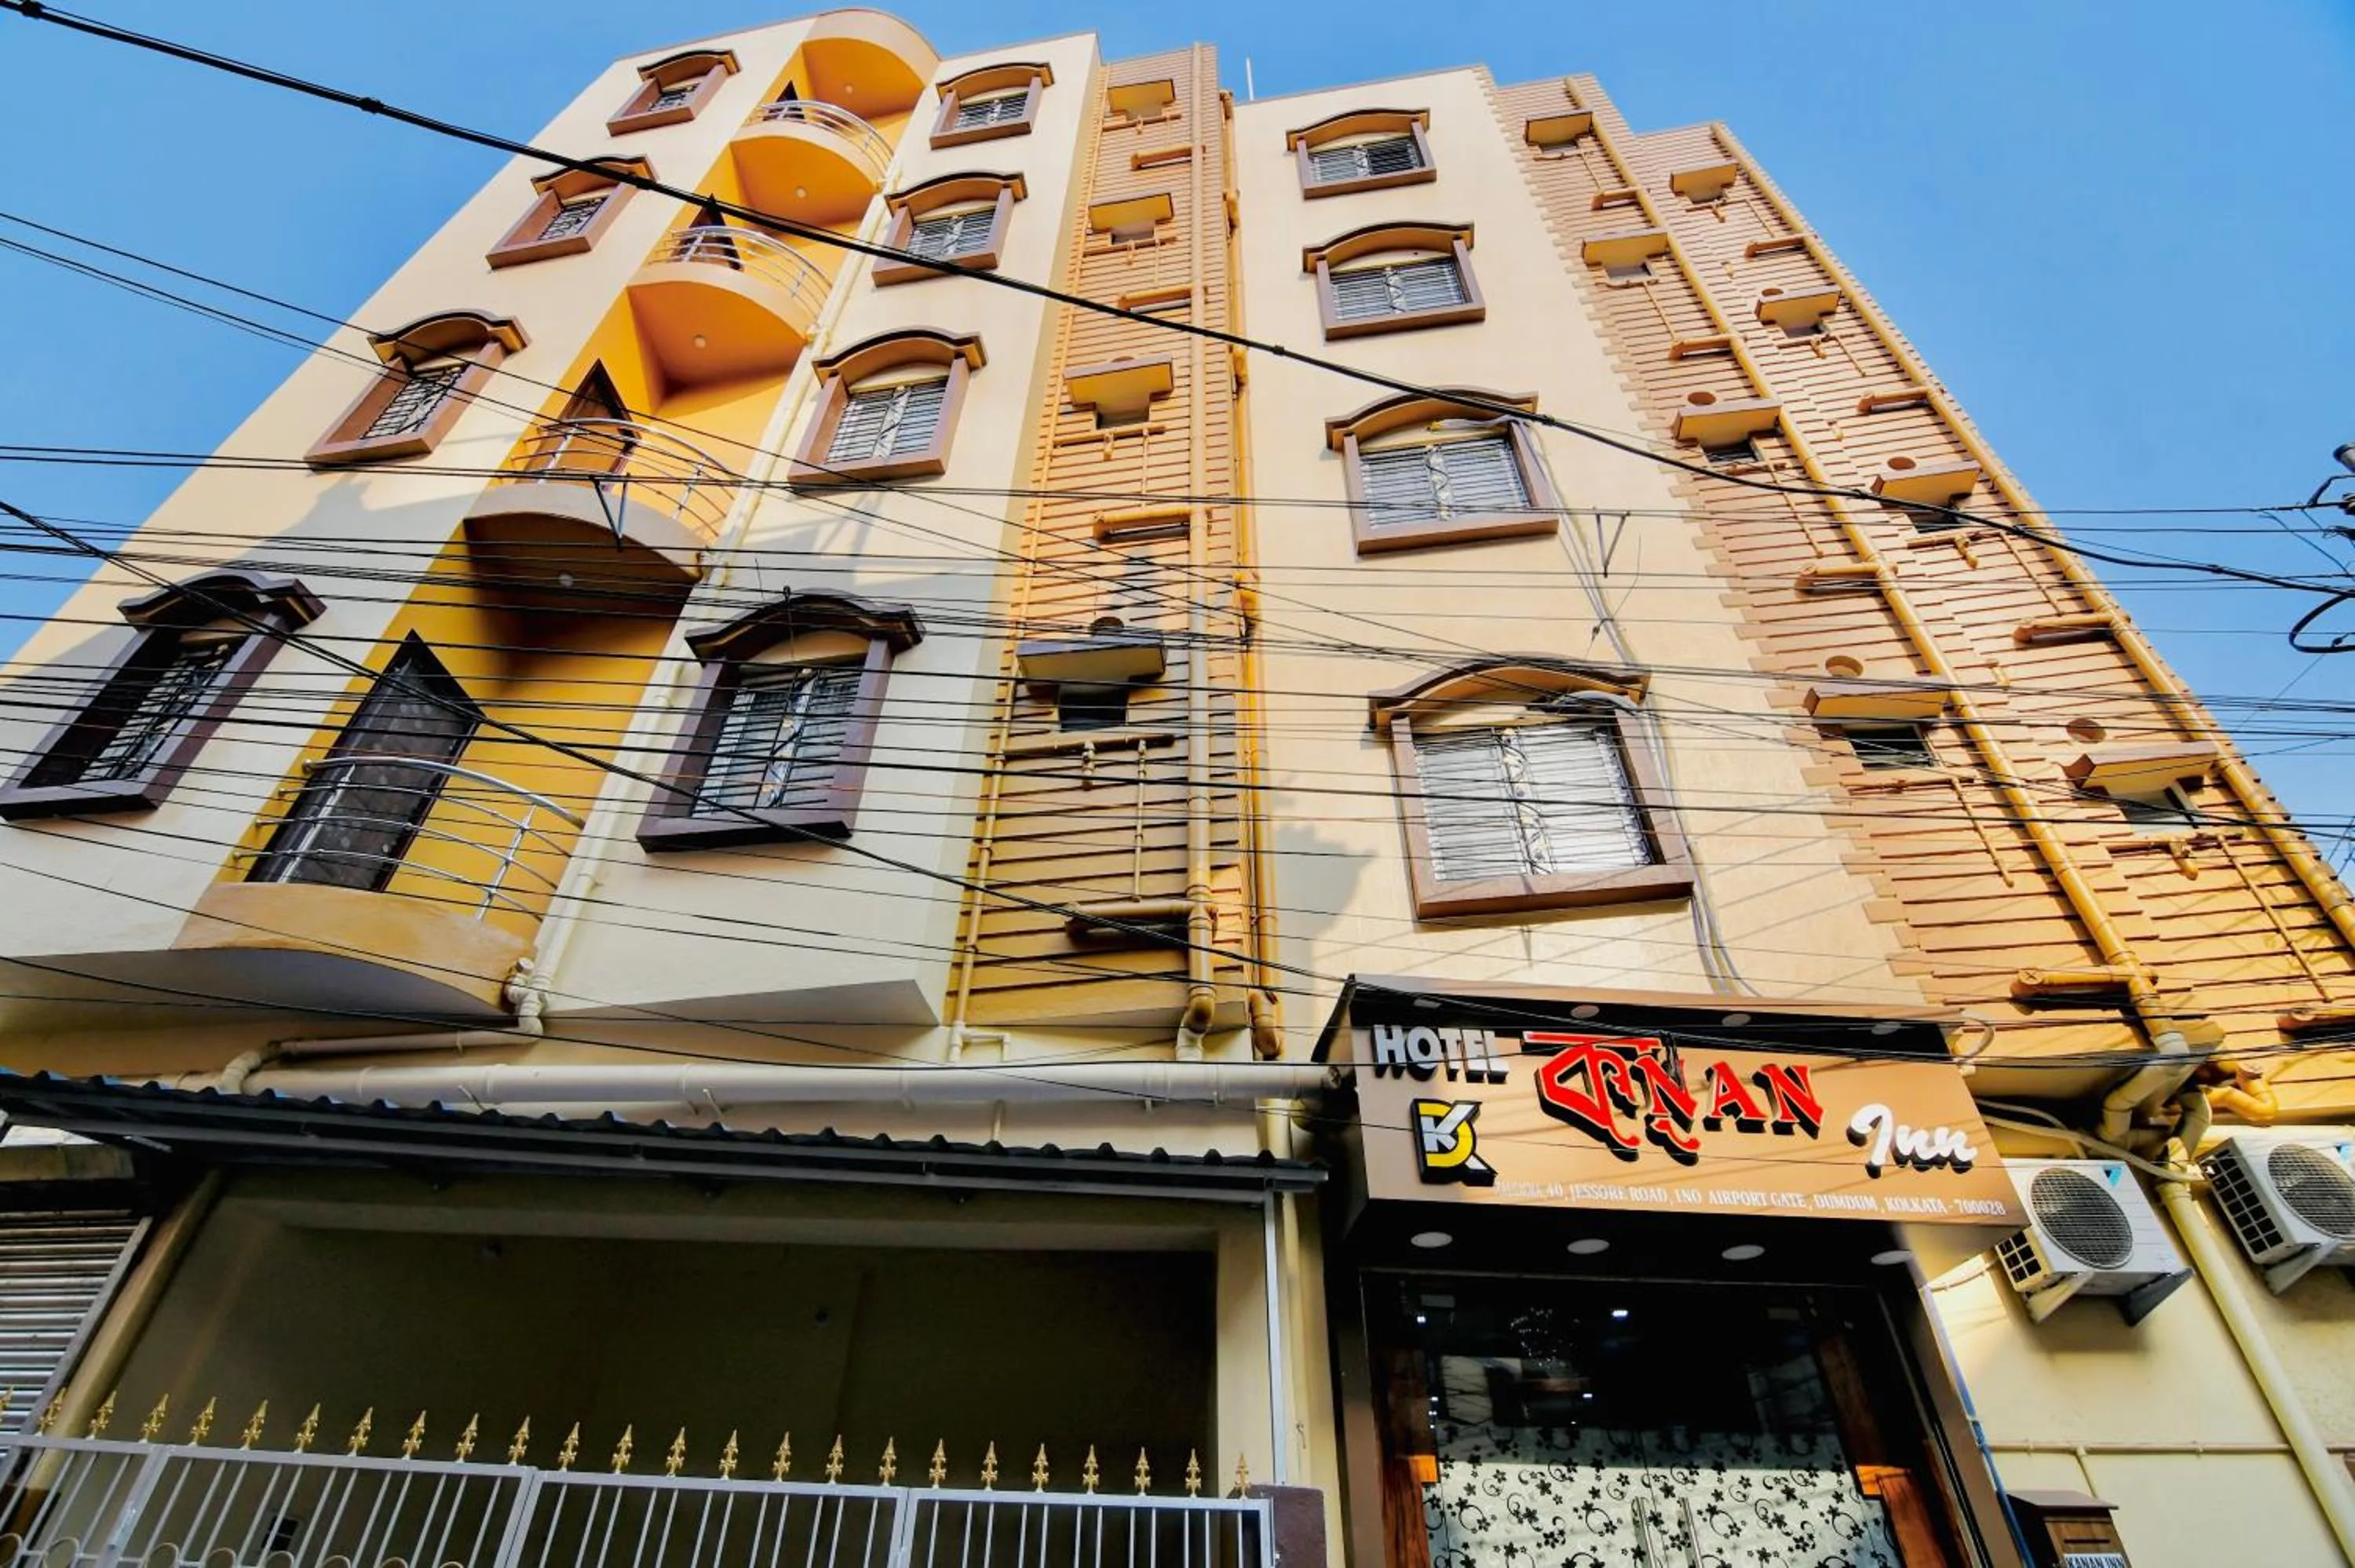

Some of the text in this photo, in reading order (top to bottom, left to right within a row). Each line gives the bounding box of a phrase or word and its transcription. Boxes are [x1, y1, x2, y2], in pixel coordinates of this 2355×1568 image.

[1373, 1024, 1509, 1084] HOTEL
[1848, 1103, 1977, 1174] Inn
[1570, 1183, 1626, 1202] JESSORE
[1708, 1189, 1769, 1209] AIRPORT
[1886, 1196, 1948, 1216] KOLKATA
[1958, 1198, 2006, 1217] 700028
